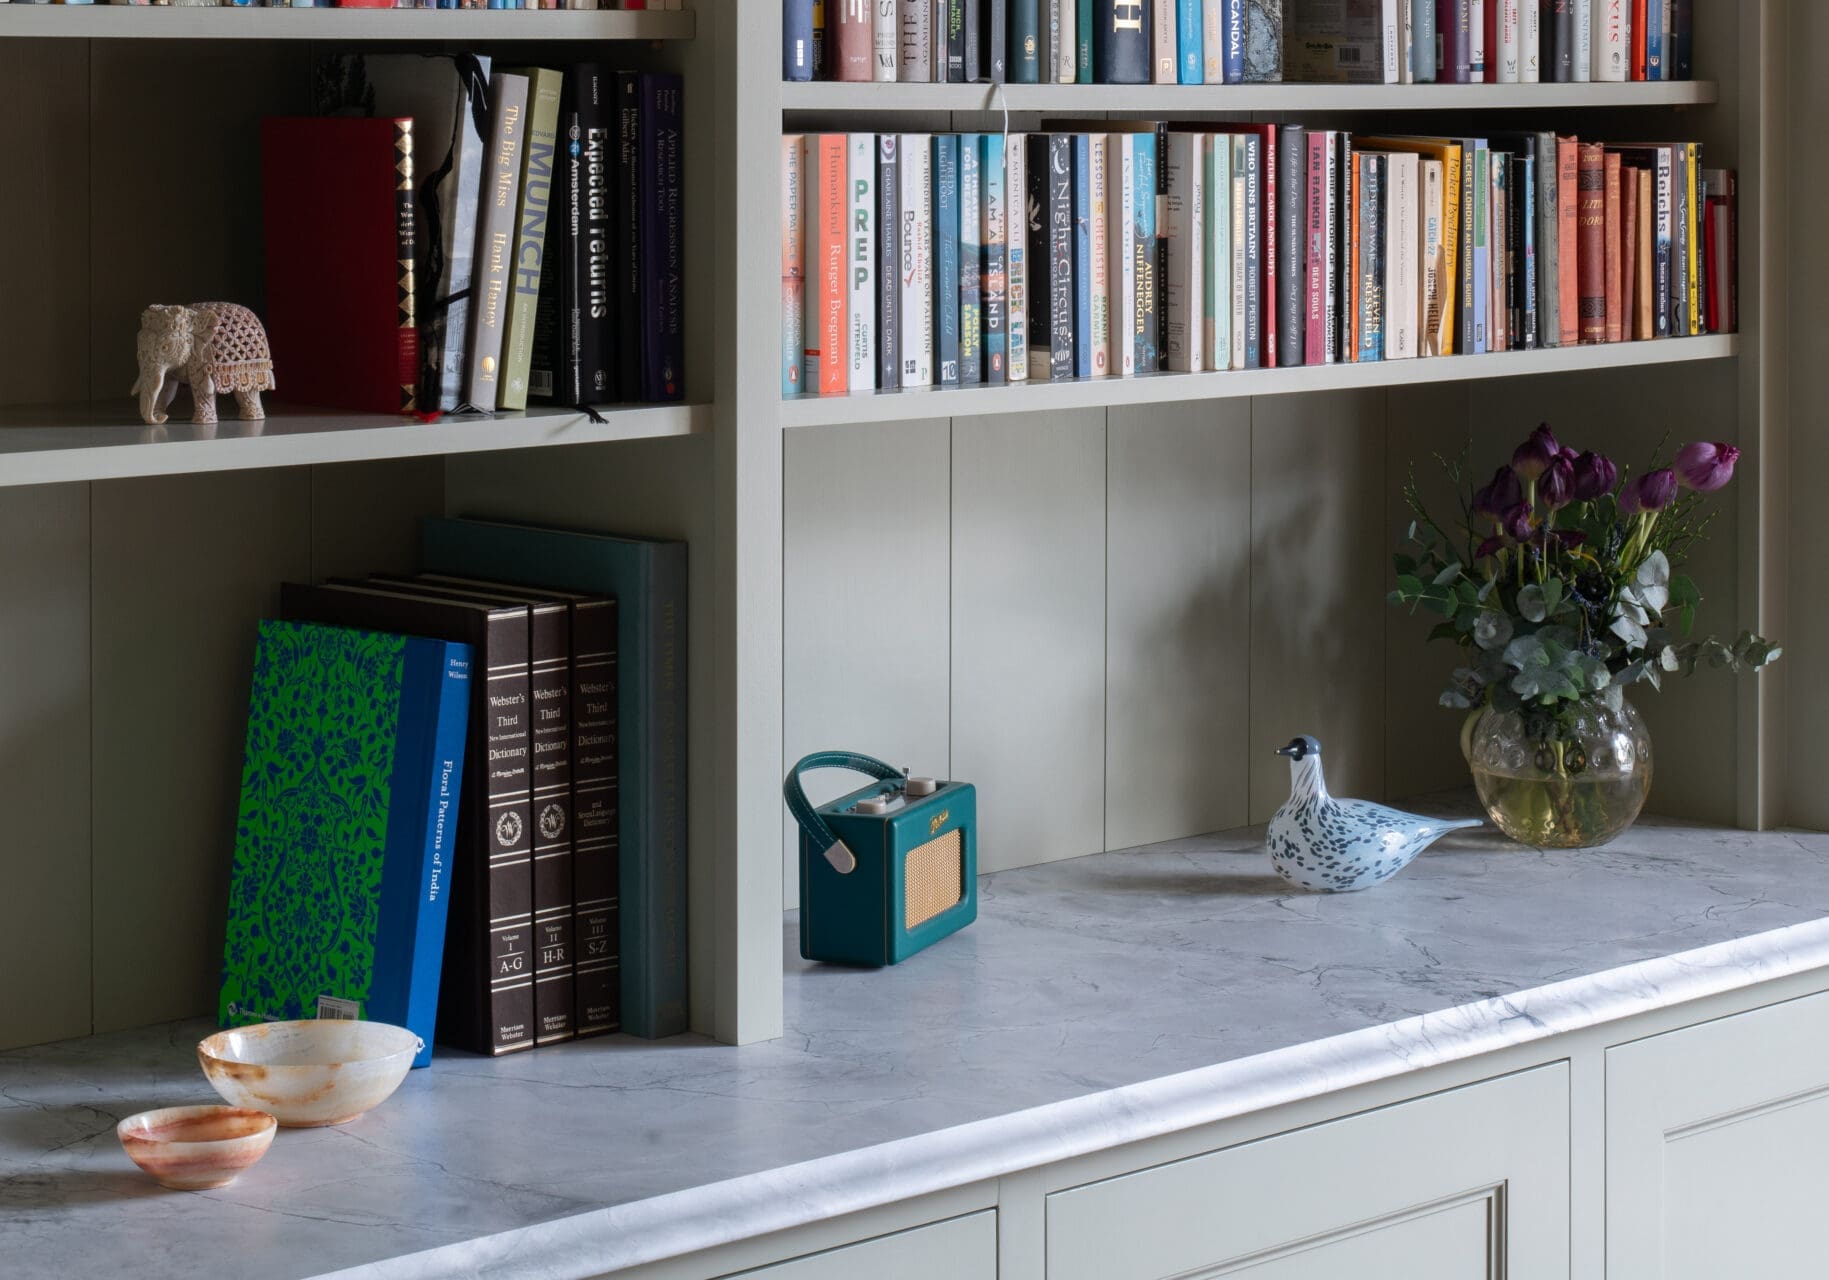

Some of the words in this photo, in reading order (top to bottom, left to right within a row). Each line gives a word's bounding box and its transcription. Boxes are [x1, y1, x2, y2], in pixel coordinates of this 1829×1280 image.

[903, 15, 917, 66] THE
[504, 105, 518, 135] The
[498, 140, 515, 167] Big
[583, 127, 607, 220] Expected
[1248, 141, 1256, 173] WHO
[497, 171, 512, 207] Miss
[569, 159, 581, 236] Amsterdam
[830, 146, 840, 235] Humankind
[1248, 176, 1256, 203] RUNS
[1658, 166, 1671, 232] Reichs
[516, 142, 553, 297] MUNCH
[854, 180, 868, 290] PREP
[903, 211, 915, 271] Bounce
[1248, 207, 1256, 259] BRITAIN?
[490, 232, 507, 274] Hank
[588, 227, 607, 319] returns
[829, 244, 840, 295] Rutger
[482, 279, 502, 328] Haney
[1136, 244, 1145, 335] NIFFENEGGER
[1144, 262, 1152, 314] AUDREY
[829, 299, 840, 365] Bregman
[490, 694, 525, 707] Webster's
[497, 715, 518, 727] Third
[489, 747, 527, 760] Dictionary
[439, 760, 453, 797] Floral
[432, 801, 448, 849] Patterns
[432, 853, 444, 865] of
[428, 868, 442, 902] India
[500, 958, 522, 973] A-G
[544, 948, 564, 963] H-R
